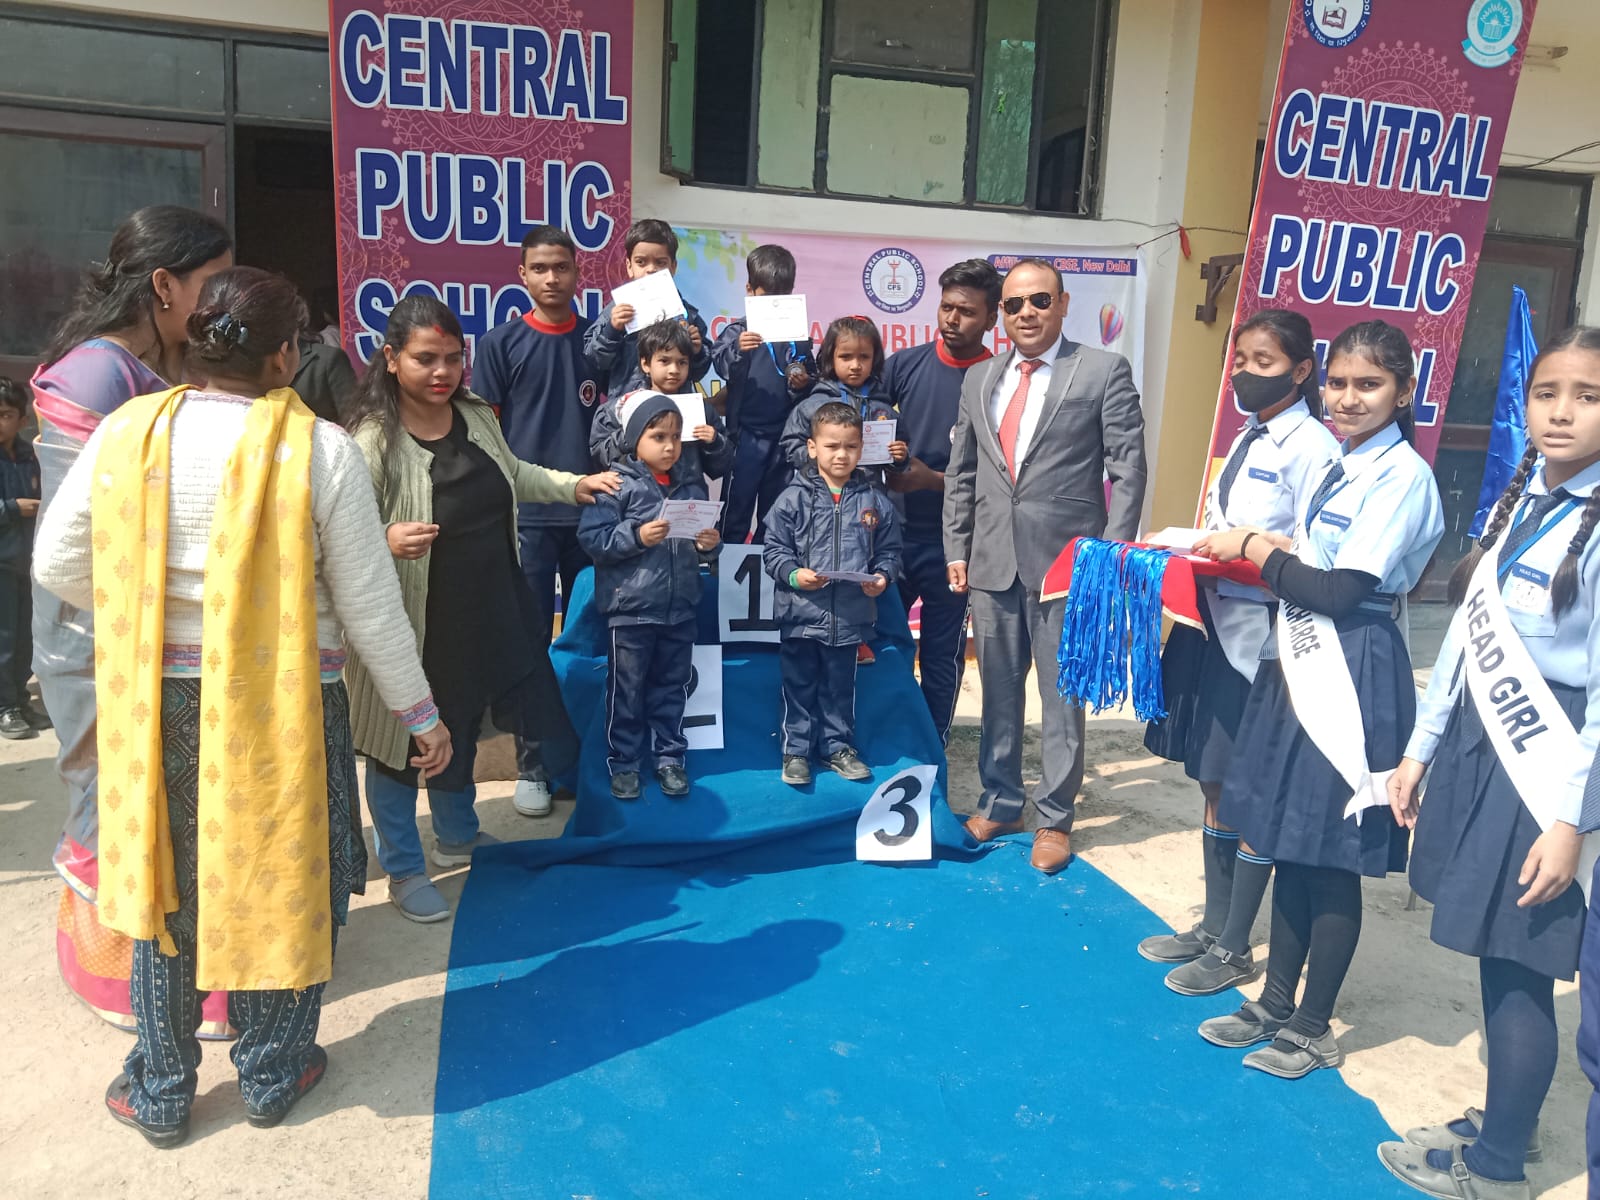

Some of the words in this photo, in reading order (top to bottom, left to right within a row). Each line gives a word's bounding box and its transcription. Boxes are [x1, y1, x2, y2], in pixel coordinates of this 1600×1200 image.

[340, 9, 627, 125] CENTRAL
[1274, 88, 1493, 201] CENTRAL
[355, 148, 614, 252] PUBLIC
[864, 254, 881, 289] CENTRAL
[881, 249, 911, 259] PUBLIC
[910, 258, 924, 292] SCHOOL
[1082, 259, 1105, 272] New
[1106, 259, 1131, 273] Delhi
[1258, 214, 1467, 315] PUBLIC
[728, 554, 781, 632] 1
[1467, 587, 1505, 674] HEAD
[1489, 676, 1549, 755] GIRL
[873, 775, 922, 847] 3
